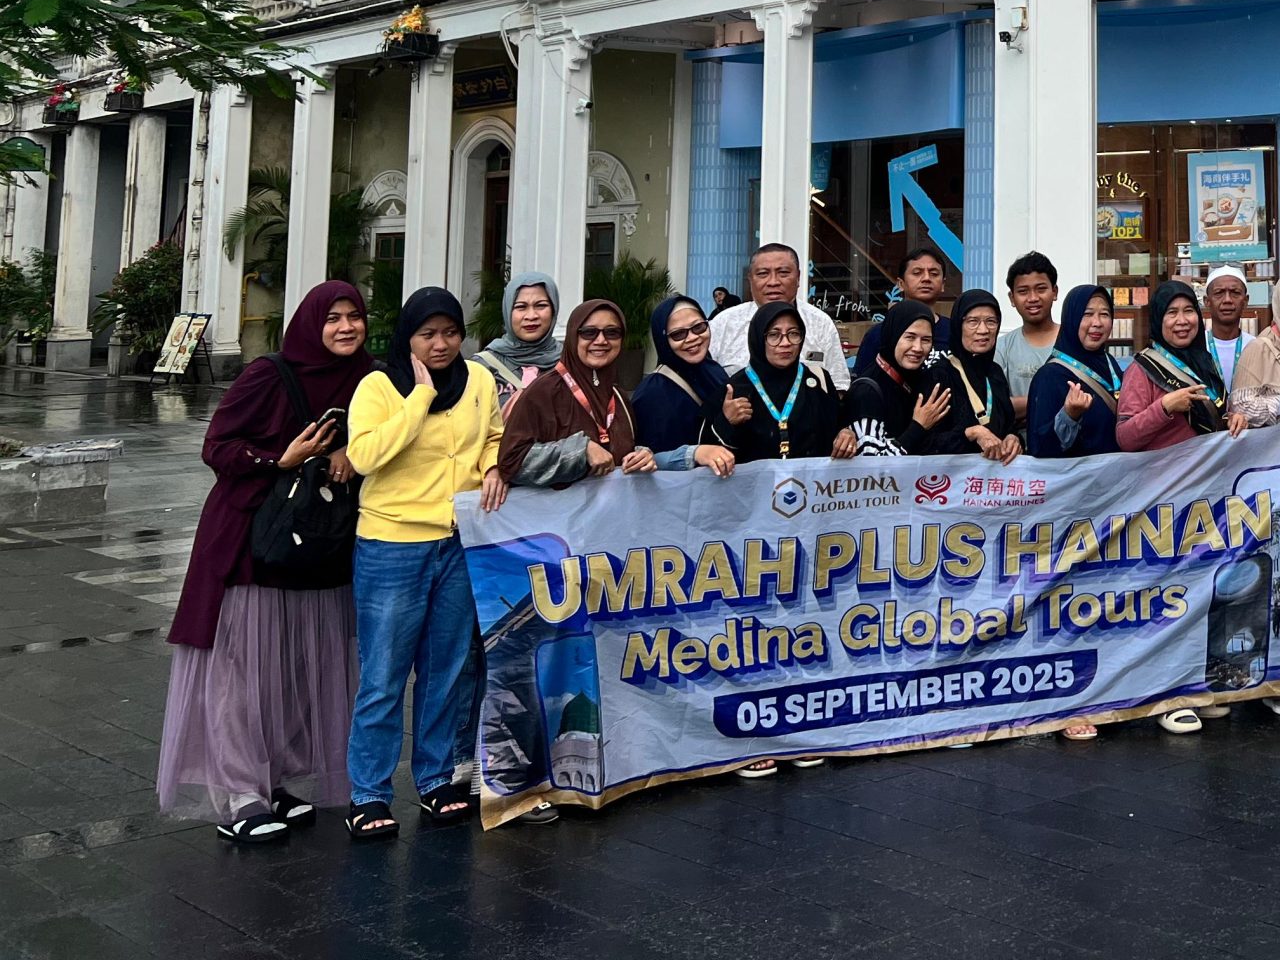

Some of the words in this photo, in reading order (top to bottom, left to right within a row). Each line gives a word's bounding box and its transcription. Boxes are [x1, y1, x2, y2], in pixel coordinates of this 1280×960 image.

[1116, 171, 1140, 194] the
[1111, 226, 1143, 238] TOP1
[835, 294, 871, 318] from
[814, 475, 901, 498] MEDINA
[963, 476, 1047, 497] 海南航空
[811, 499, 861, 515] GLOBAL
[864, 495, 900, 508] TOUR
[963, 498, 1001, 507] HAINAN
[1005, 497, 1046, 507] AIRLINES
[527, 537, 800, 626] UMRAH
[813, 522, 987, 594] PLUS
[1002, 488, 1274, 577] HAINAN
[620, 617, 826, 681] Medina
[838, 596, 1027, 651] Global
[1040, 582, 1189, 631] Tours
[736, 696, 779, 732] 05
[784, 670, 986, 724] SEPTEMBER
[991, 659, 1076, 696] 2025
